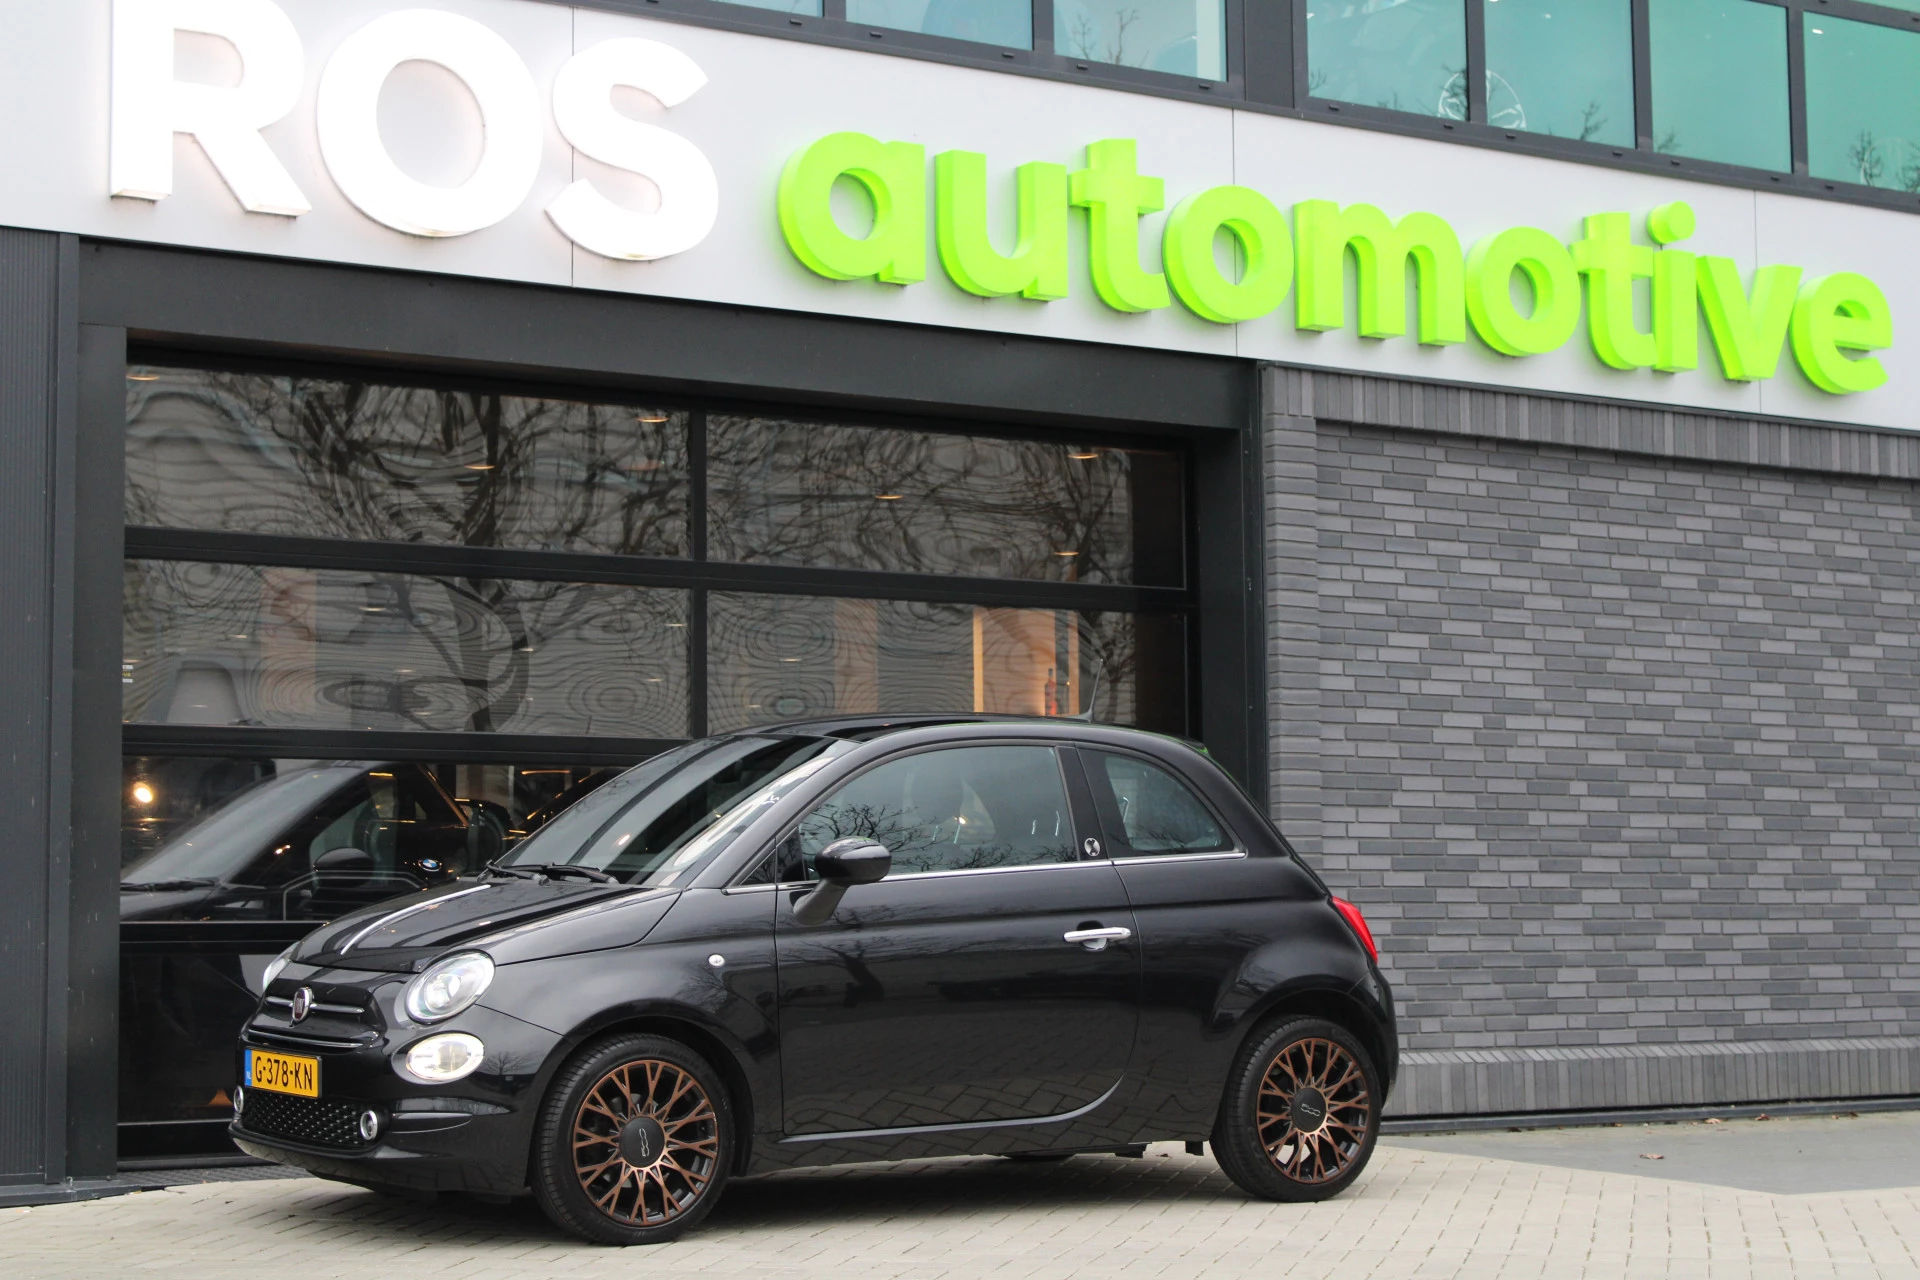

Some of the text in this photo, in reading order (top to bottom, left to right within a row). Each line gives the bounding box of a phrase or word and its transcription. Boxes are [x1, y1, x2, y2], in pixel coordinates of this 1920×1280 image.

[110, 0, 1894, 395] ROS automotive
[255, 1056, 313, 1091] G-378-KN
